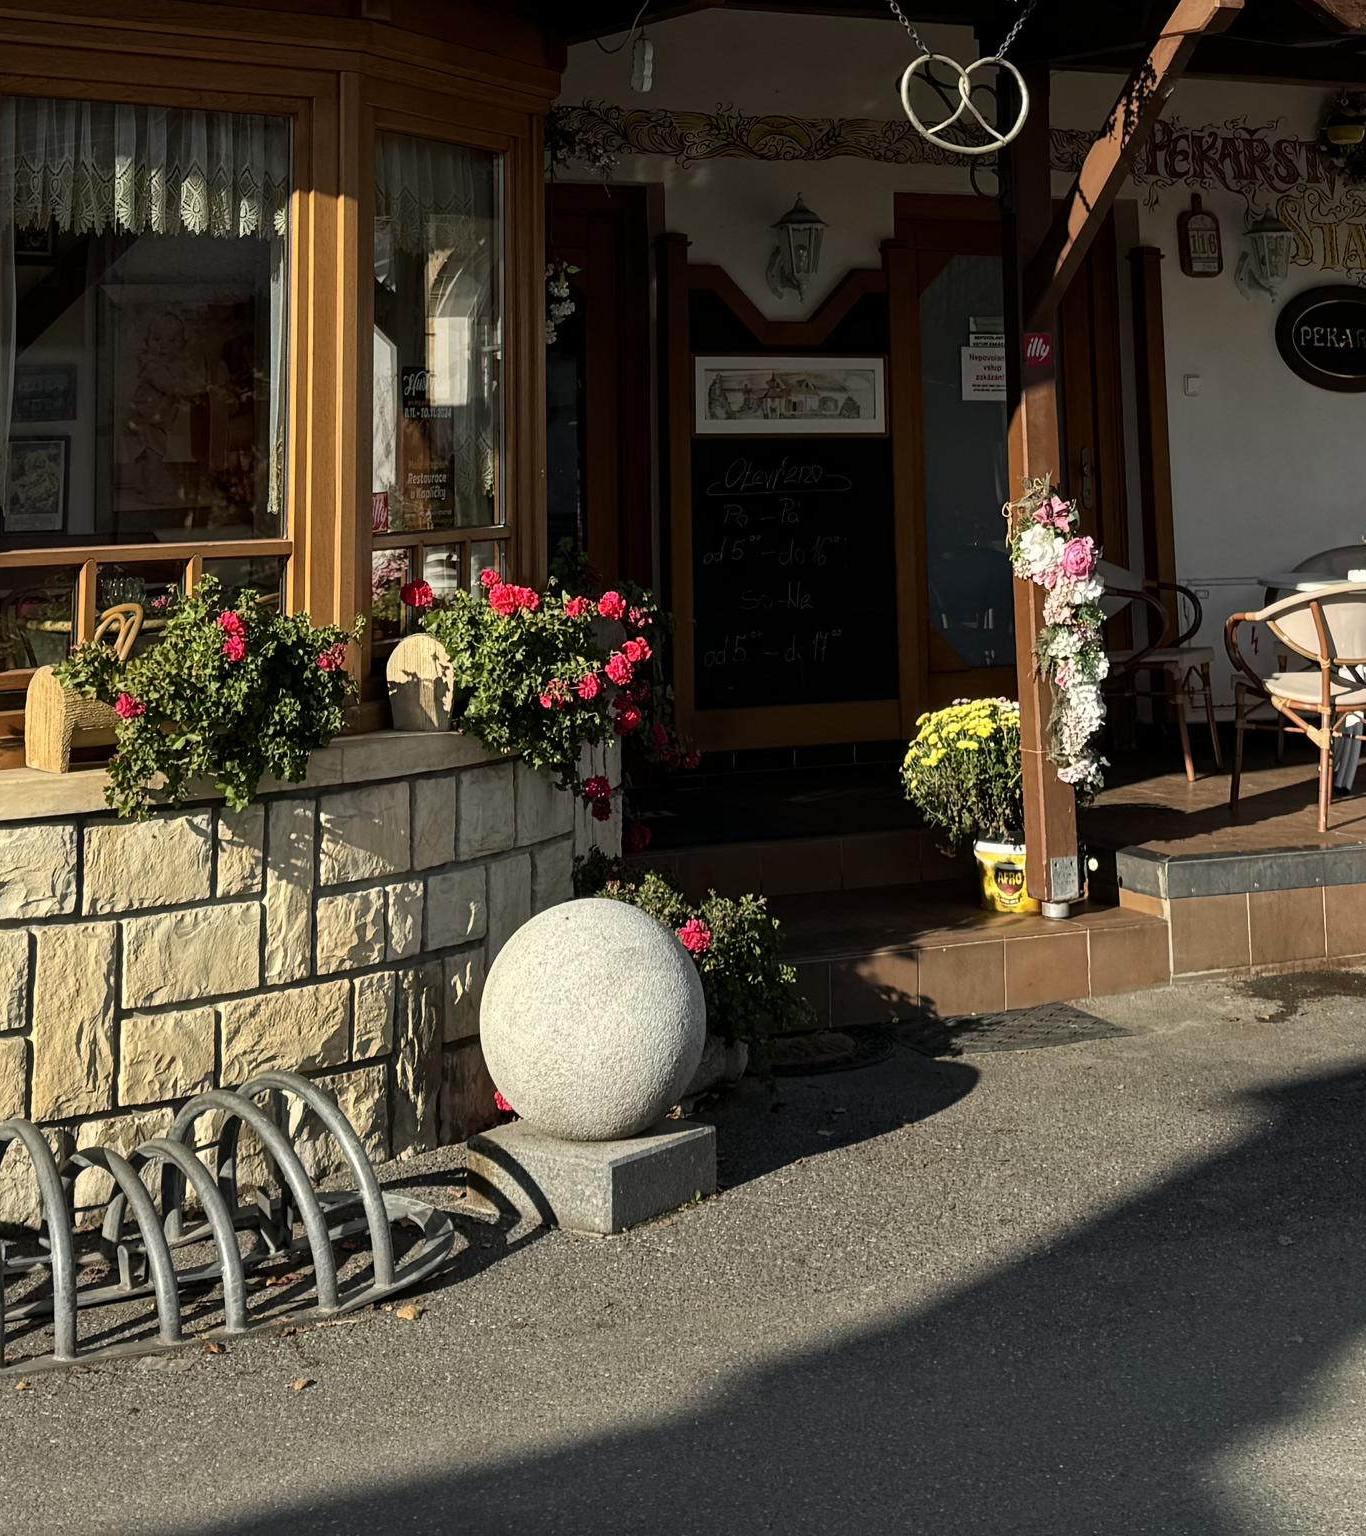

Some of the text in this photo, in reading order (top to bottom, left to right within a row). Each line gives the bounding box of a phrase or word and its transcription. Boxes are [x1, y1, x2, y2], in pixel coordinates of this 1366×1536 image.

[1144, 120, 1337, 197] PEKAŘSTV
[1190, 233, 1217, 254] 116
[1026, 335, 1050, 361] illy
[408, 472, 448, 484] Restaurace
[723, 503, 749, 527] Po
[702, 536, 727, 566] od
[703, 632, 728, 668] od
[997, 870, 1023, 885] AFRO
